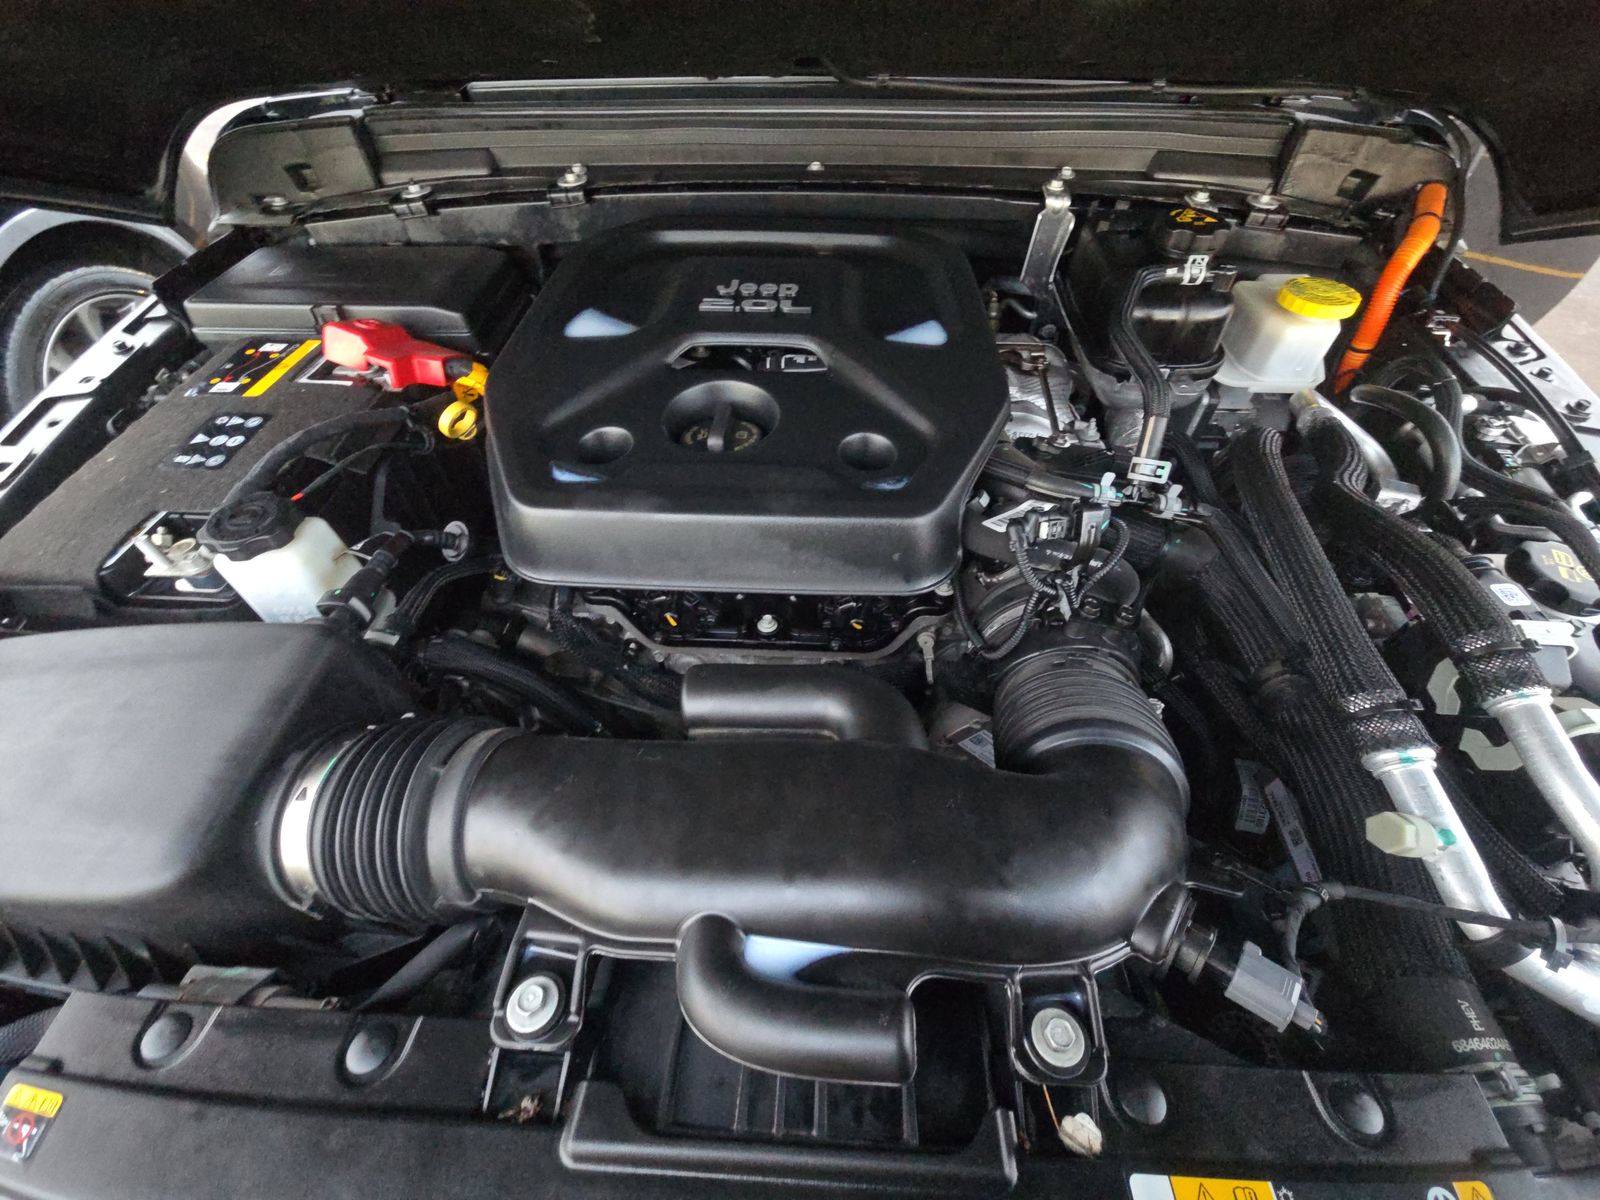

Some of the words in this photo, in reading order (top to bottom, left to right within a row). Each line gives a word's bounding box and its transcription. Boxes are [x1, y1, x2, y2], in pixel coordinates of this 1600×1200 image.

[716, 279, 799, 297] Jeep
[698, 298, 812, 313] 2.0L
[1457, 999, 1485, 1031] PHEV
